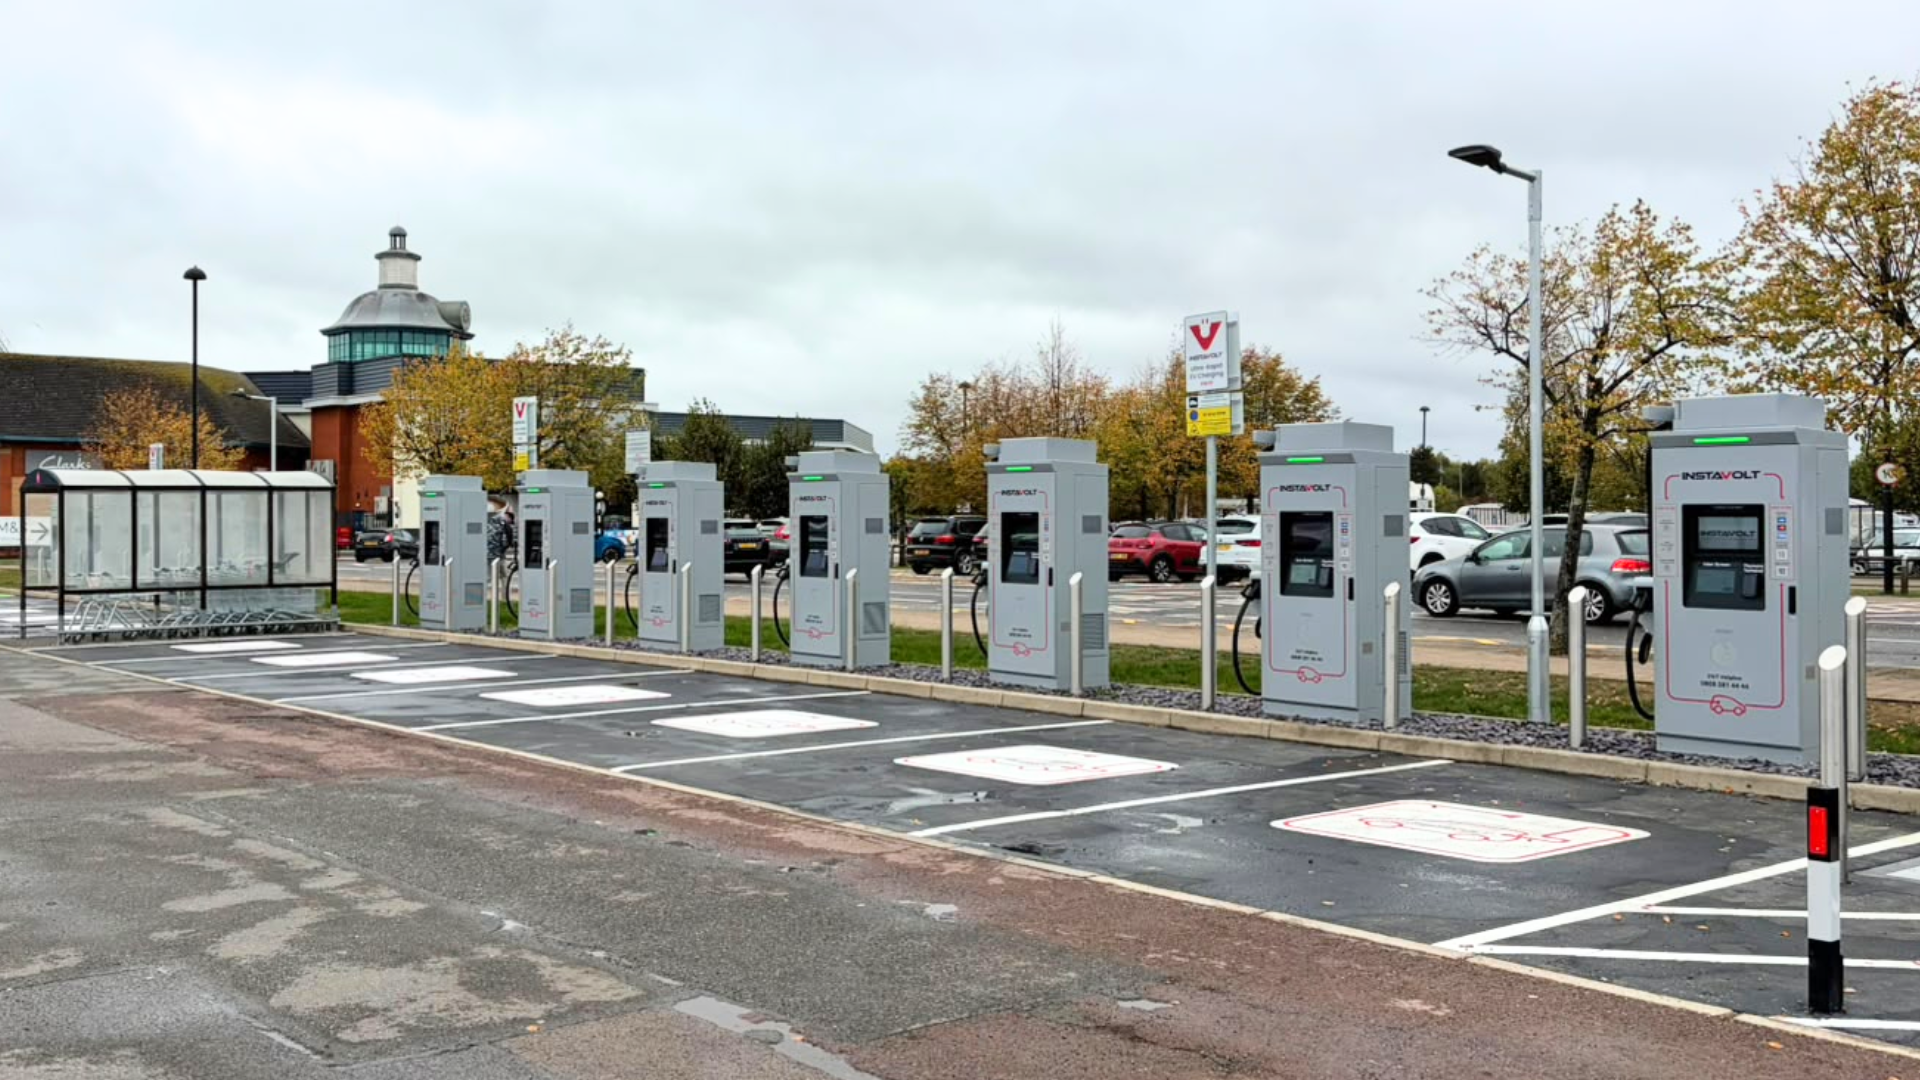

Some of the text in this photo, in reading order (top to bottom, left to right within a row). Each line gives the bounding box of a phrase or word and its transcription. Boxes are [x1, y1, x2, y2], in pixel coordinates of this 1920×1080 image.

[38, 454, 92, 469] Clarks
[1681, 470, 1761, 480] INSTAVOLT
[1280, 484, 1331, 492] INSTAVOLT
